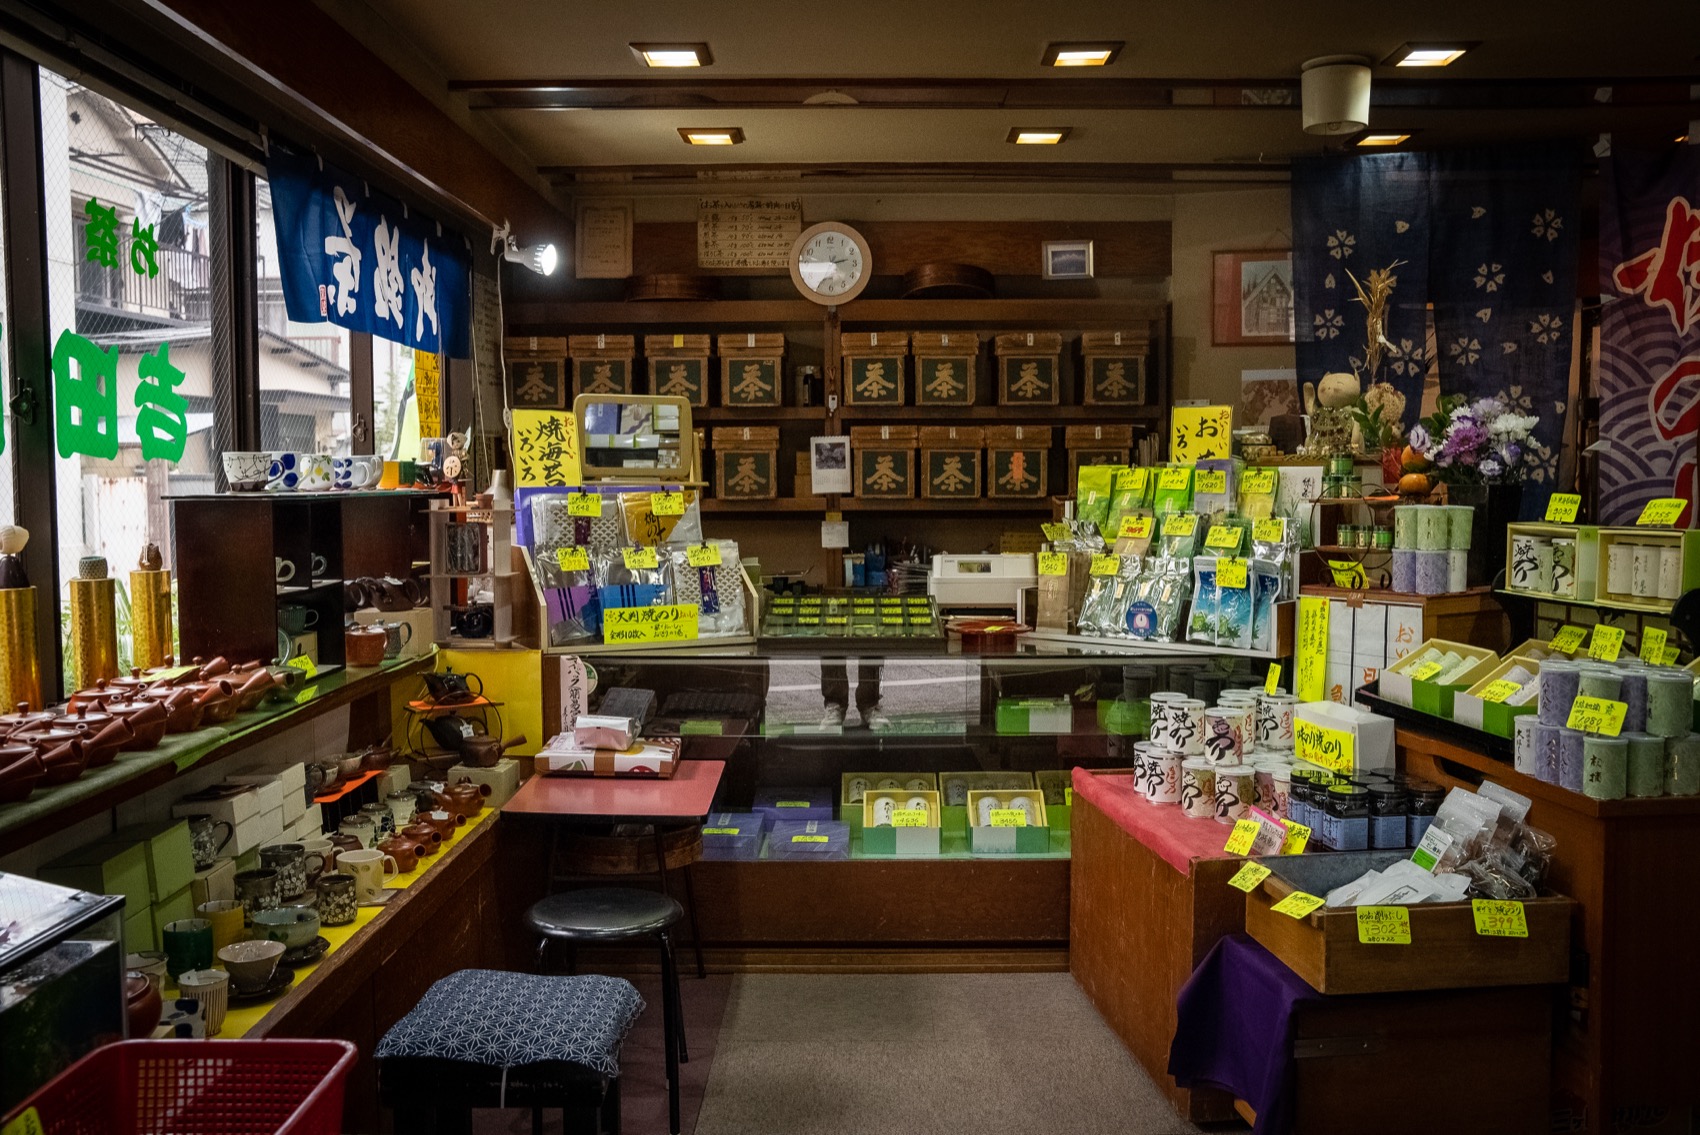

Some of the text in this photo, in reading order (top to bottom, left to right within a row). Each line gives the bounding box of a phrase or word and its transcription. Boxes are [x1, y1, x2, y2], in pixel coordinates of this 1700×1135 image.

[806, 248, 813, 256] 10
[827, 236, 834, 244] 12
[828, 285, 834, 293] 6
[516, 364, 555, 400] 茶
[659, 364, 698, 396] 茶
[732, 363, 772, 400] 茶
[855, 362, 896, 398] 茶
[925, 362, 965, 398] 茶
[1010, 362, 1050, 398] 茶
[1096, 362, 1136, 398] 茶
[517, 428, 536, 481] いろいろ
[1176, 424, 1188, 463] いろい
[727, 456, 767, 492] 茶
[866, 455, 905, 491] 茶
[933, 455, 973, 491] 茶
[617, 607, 679, 623] 大判焼のり
[1395, 622, 1414, 658] おい
[1170, 711, 1196, 748] 焼のり
[1146, 760, 1165, 796] 焼のり
[1365, 924, 1397, 934] ¥302
